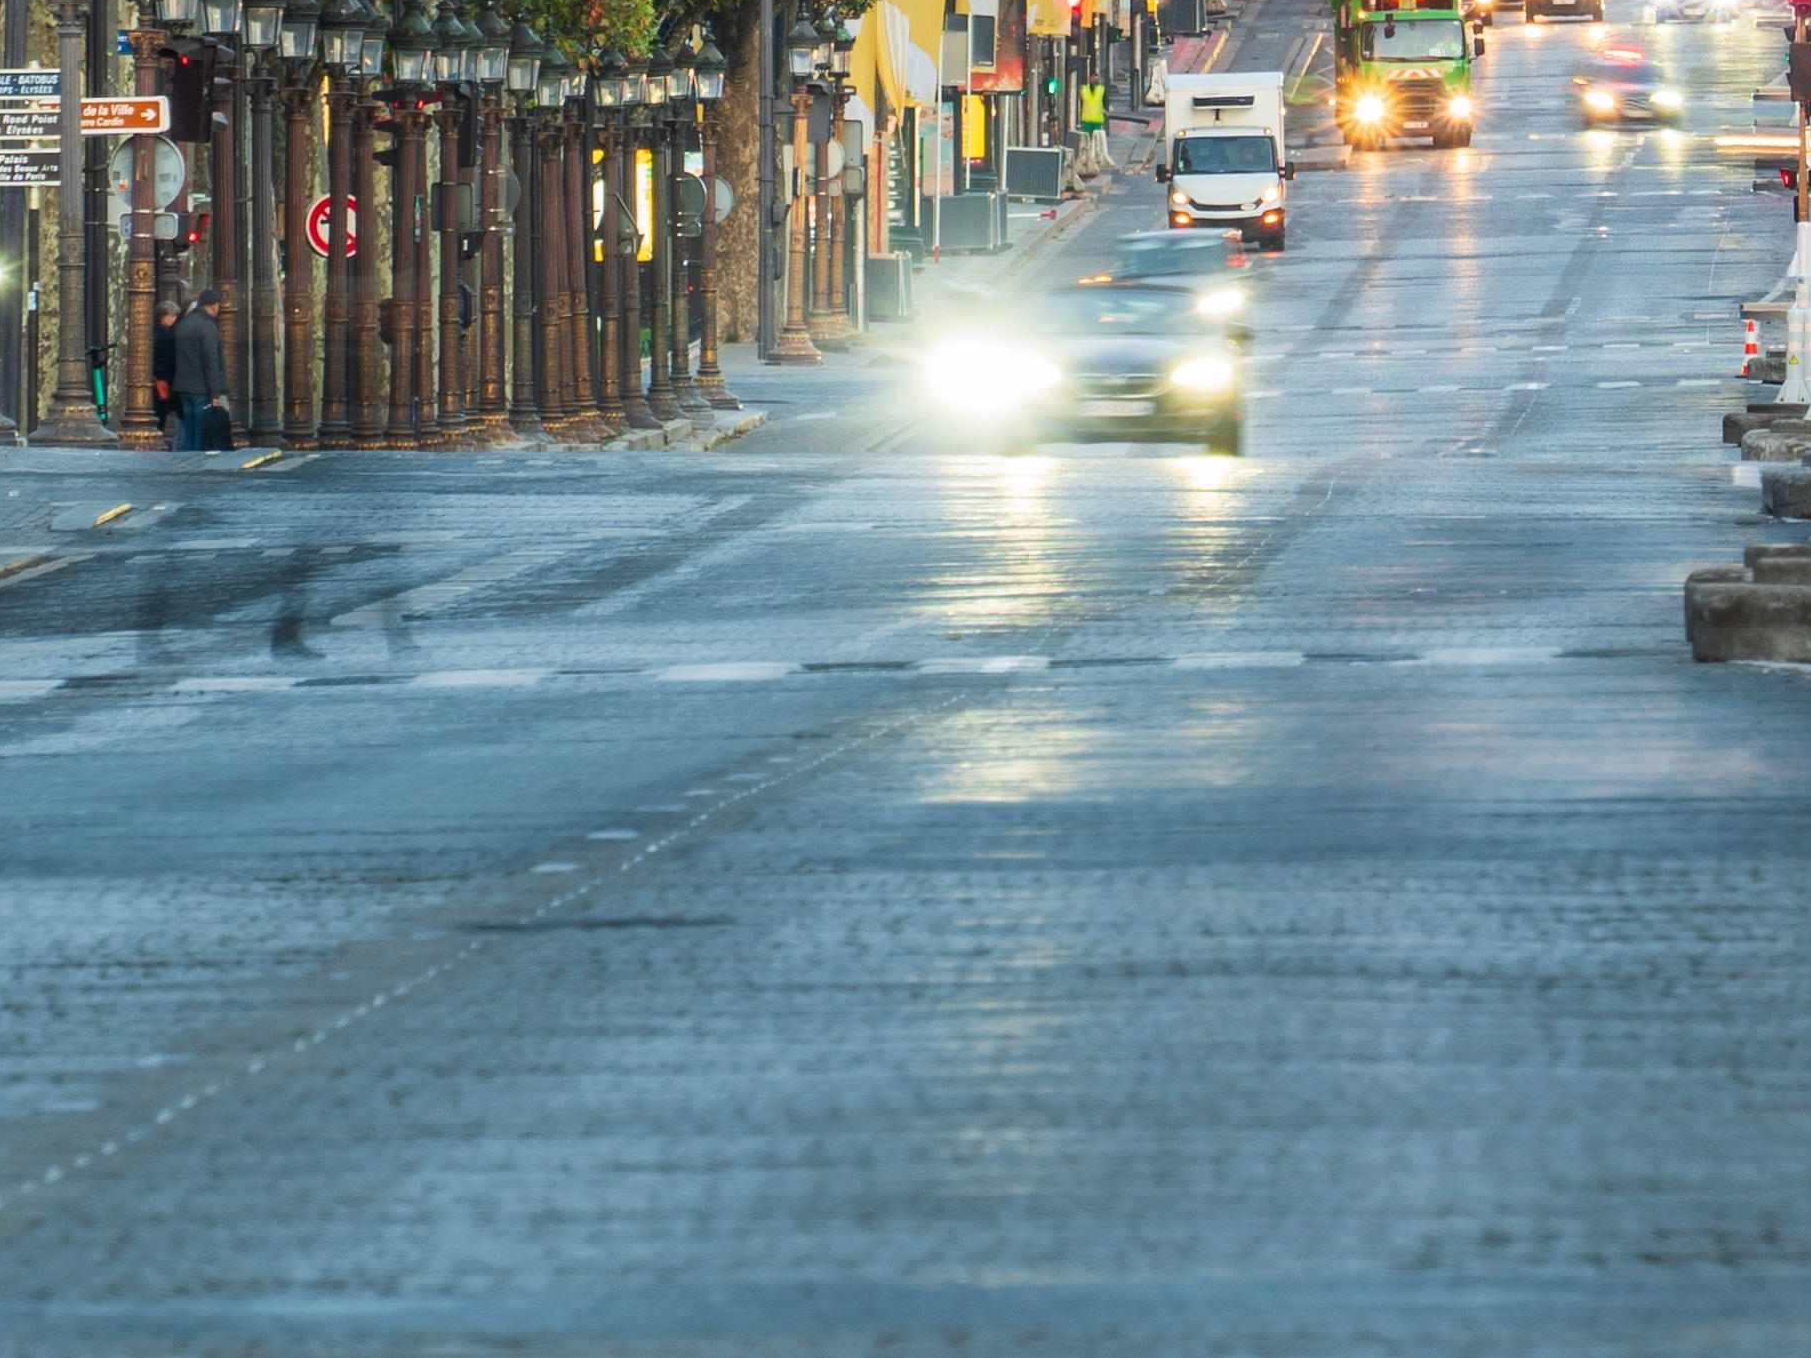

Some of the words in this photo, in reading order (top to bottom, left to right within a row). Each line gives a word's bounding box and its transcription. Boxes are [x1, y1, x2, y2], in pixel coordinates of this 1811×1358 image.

[18, 75, 59, 85] BATOBUS
[98, 104, 109, 116] la
[110, 103, 135, 116] Ville
[2, 114, 29, 124] Rond
[31, 114, 58, 124] Point
[96, 117, 124, 127] Cardin
[41, 164, 59, 172] Arts
[25, 172, 46, 181] Paris
